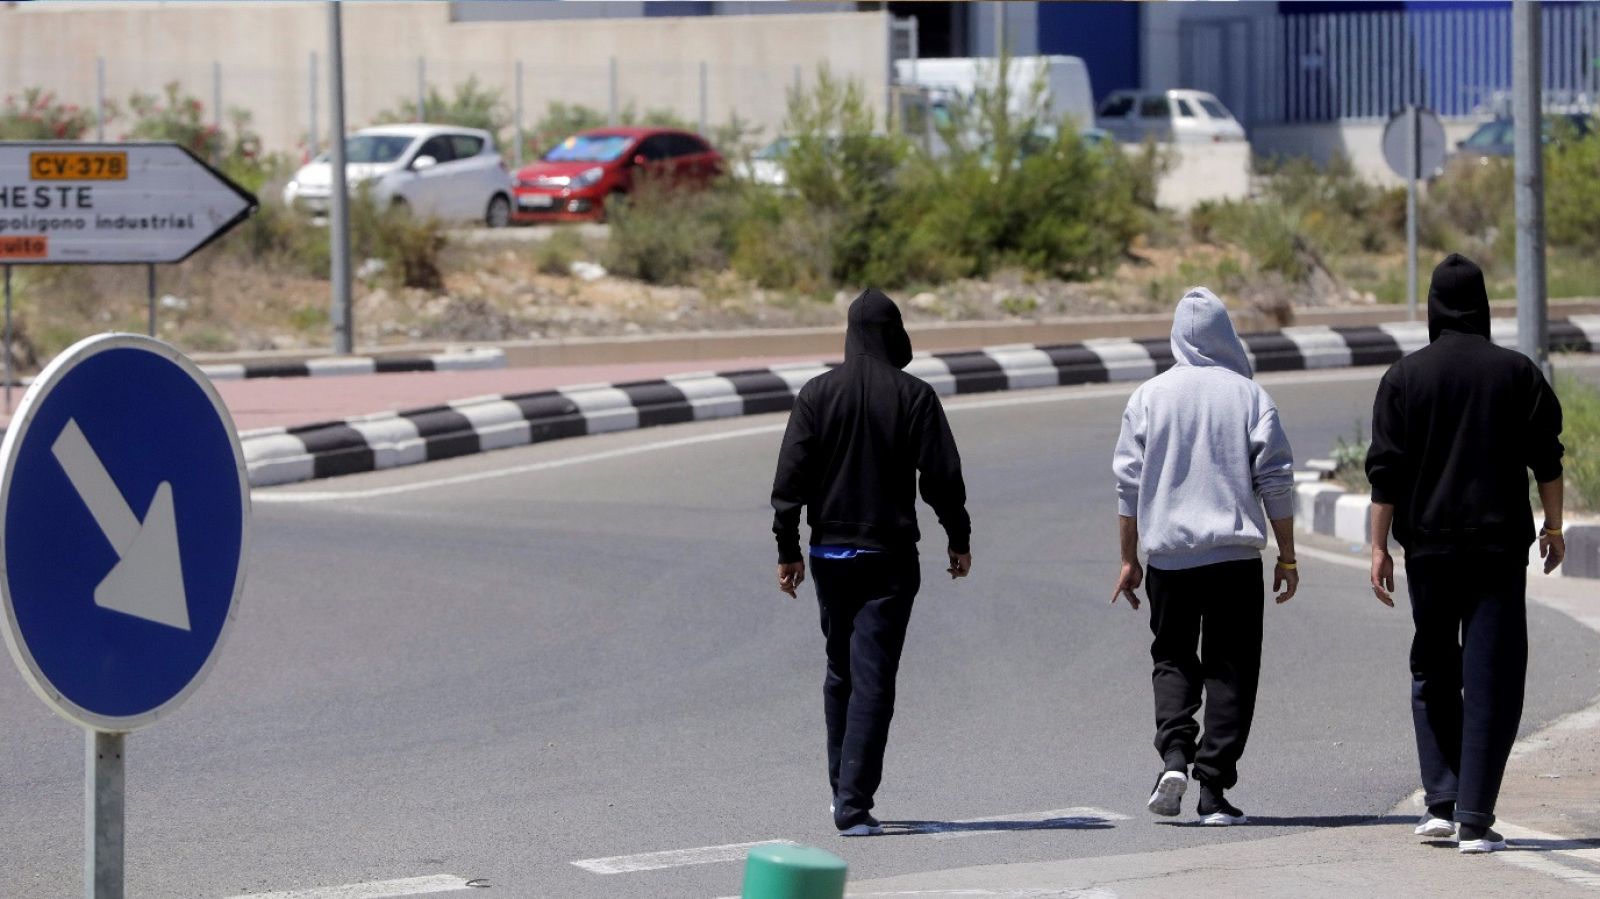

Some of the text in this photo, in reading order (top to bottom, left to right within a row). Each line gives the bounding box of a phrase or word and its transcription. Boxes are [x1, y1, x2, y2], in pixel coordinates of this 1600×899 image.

[35, 157, 122, 175] CV-378
[95, 214, 195, 229] industrial
[0, 238, 45, 254] uito
